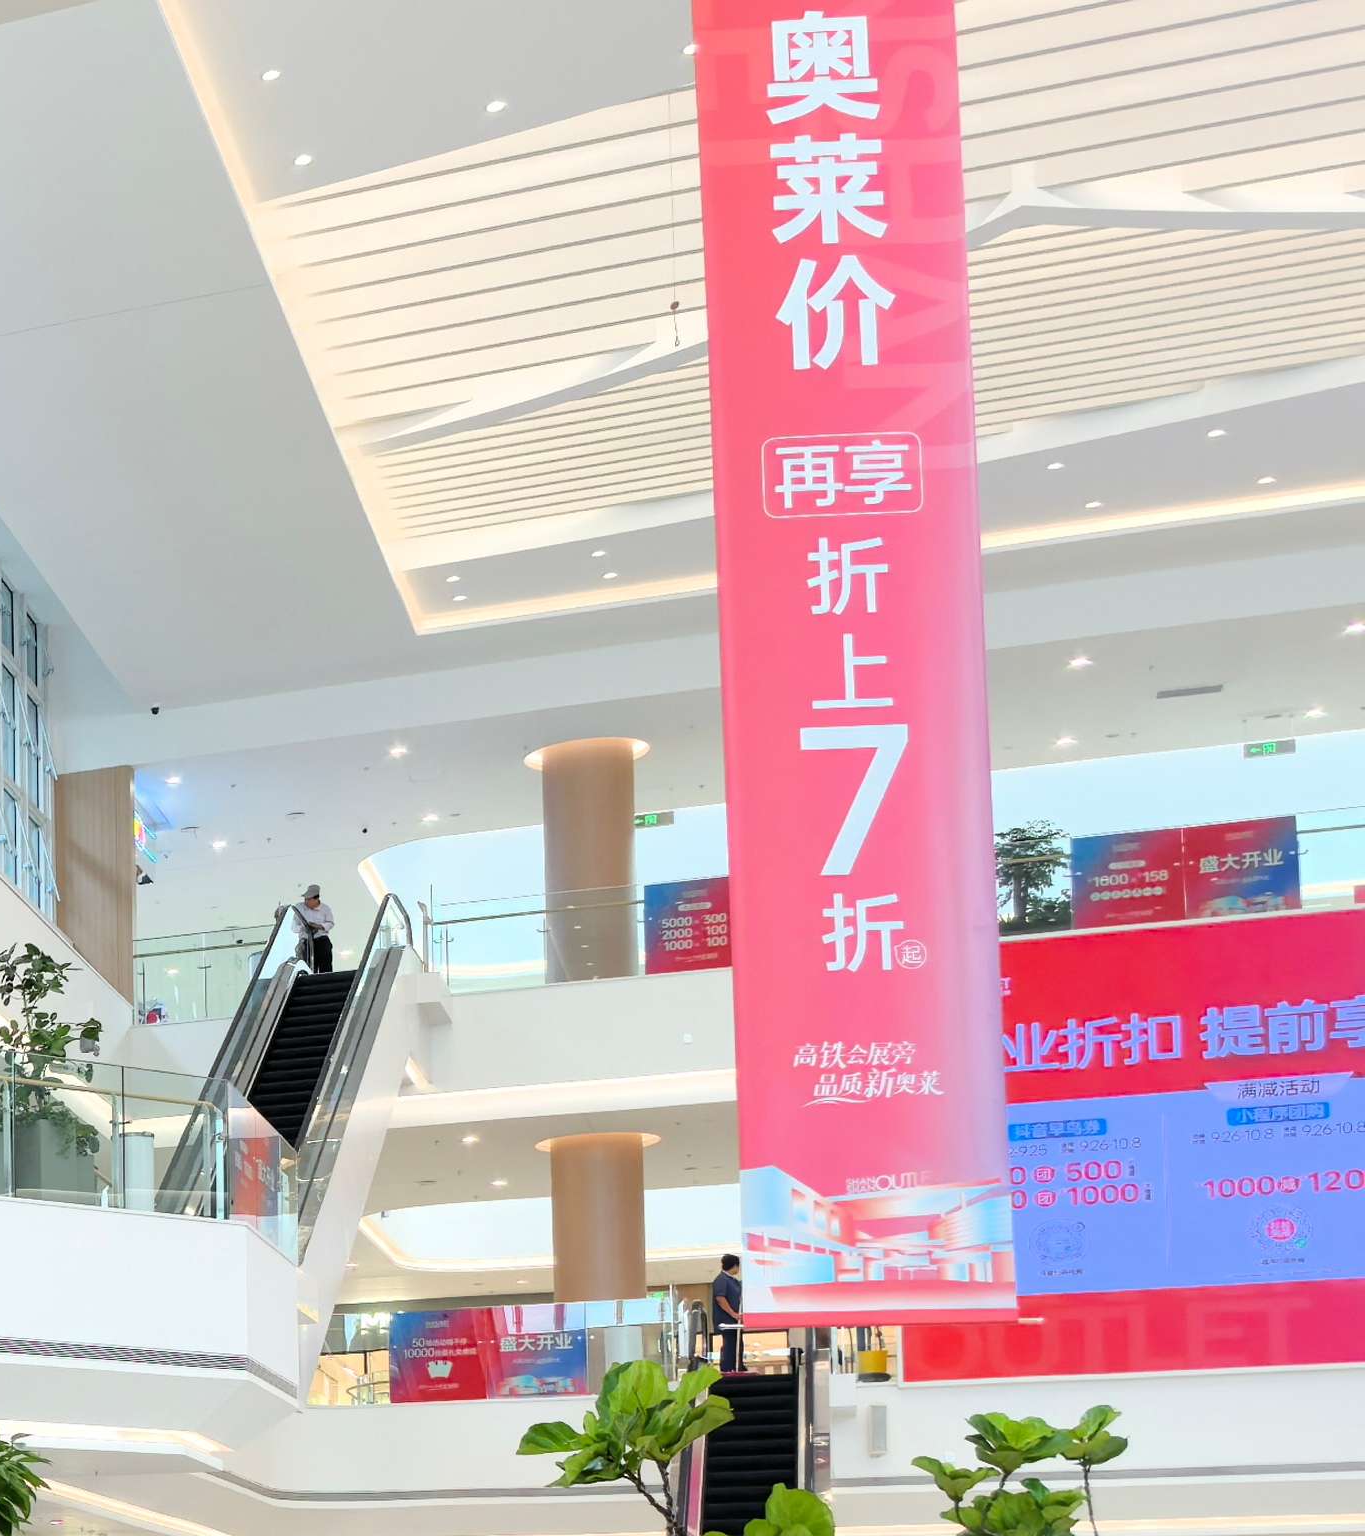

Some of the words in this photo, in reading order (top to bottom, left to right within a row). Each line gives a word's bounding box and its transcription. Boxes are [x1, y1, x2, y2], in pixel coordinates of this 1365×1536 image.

[767, 9, 896, 371] 奥莱价
[774, 440, 913, 508] 再享
[1197, 848, 1284, 875] 盛大开业
[661, 916, 693, 929] 5000
[661, 927, 693, 941] 2000
[663, 939, 693, 952] 1000
[793, 1040, 917, 1068] 高铁会展旁
[813, 1068, 945, 1098] 品质新奥莱
[1237, 1079, 1320, 1099] 满减活动
[1067, 1160, 1122, 1182] 500
[1067, 1183, 1139, 1206] 1000
[1205, 1176, 1274, 1199] 1000
[500, 1334, 573, 1352] 盛大开业
